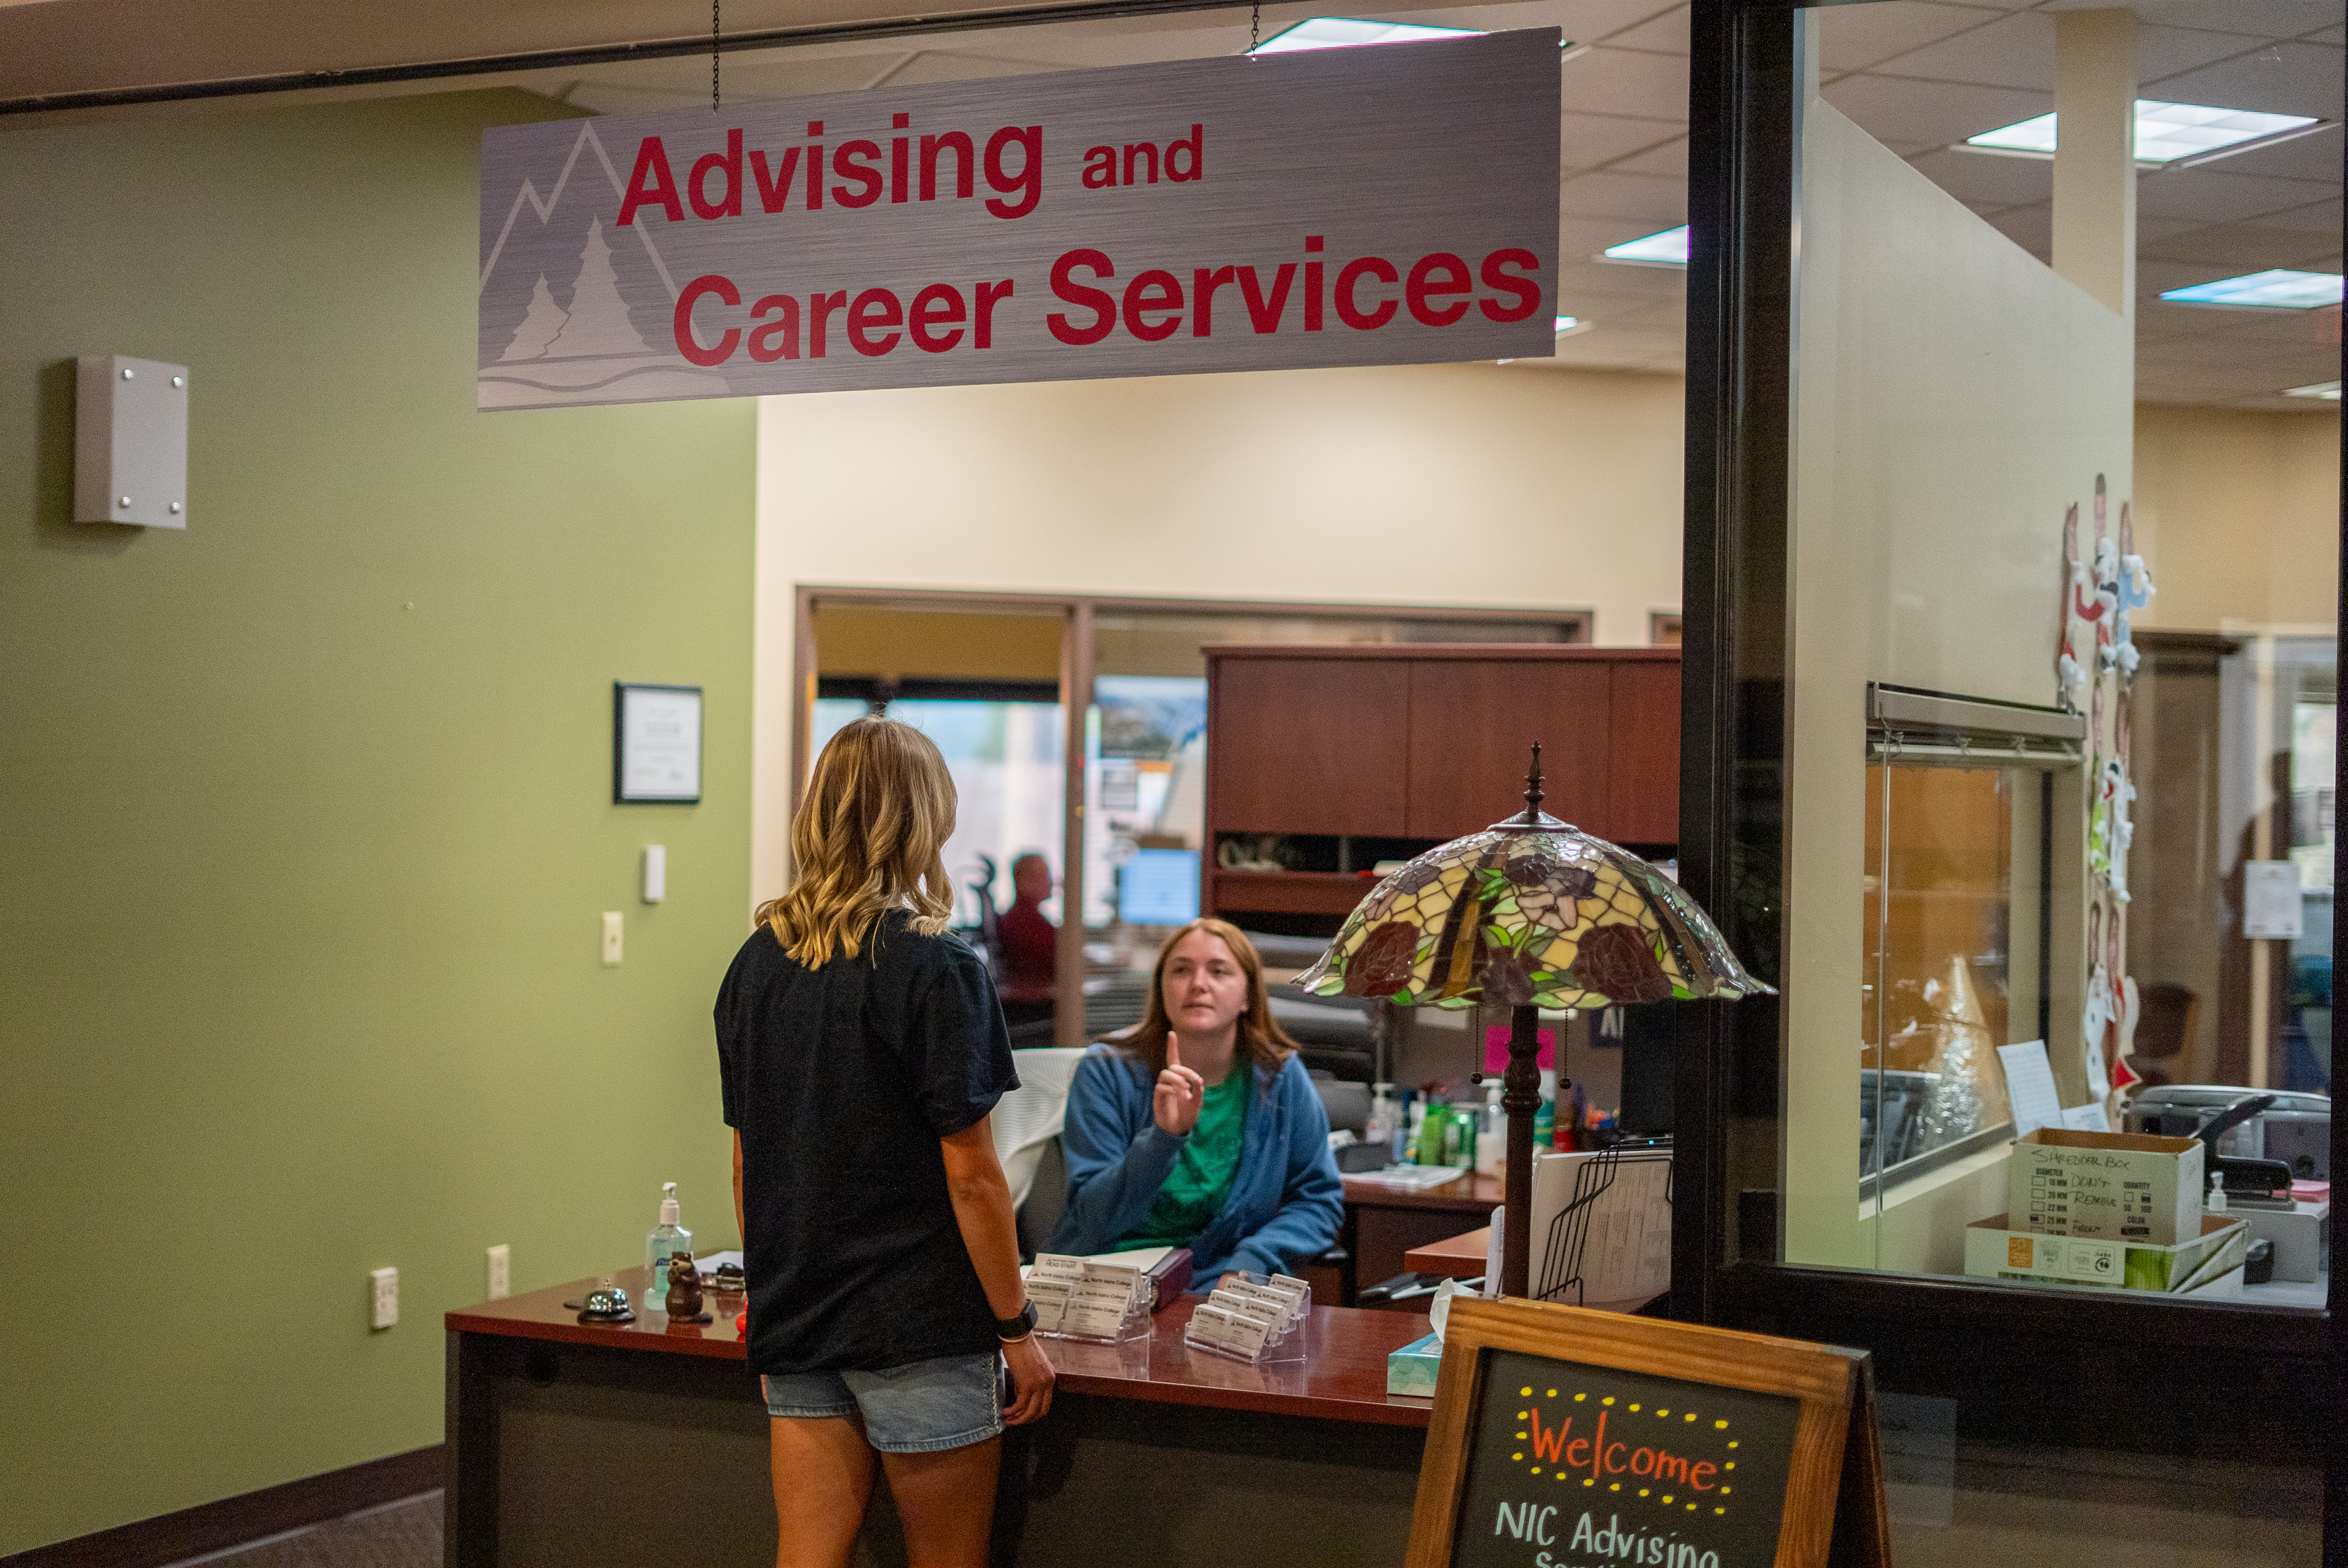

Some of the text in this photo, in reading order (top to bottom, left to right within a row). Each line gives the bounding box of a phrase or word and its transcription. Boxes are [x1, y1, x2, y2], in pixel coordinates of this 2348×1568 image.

[616, 112, 1203, 226] Advising and
[674, 235, 1541, 367] Career Services
[2104, 1156, 2130, 1169] BOX
[2056, 1179, 2068, 1187] MM
[2123, 1181, 2151, 1190] QUANTITY
[2056, 1192, 2068, 1200] MM
[2056, 1204, 2068, 1213] MM
[2055, 1216, 2067, 1225] MM
[1531, 1408, 1717, 1491] Welcome
[1495, 1502, 1557, 1545] NIC
